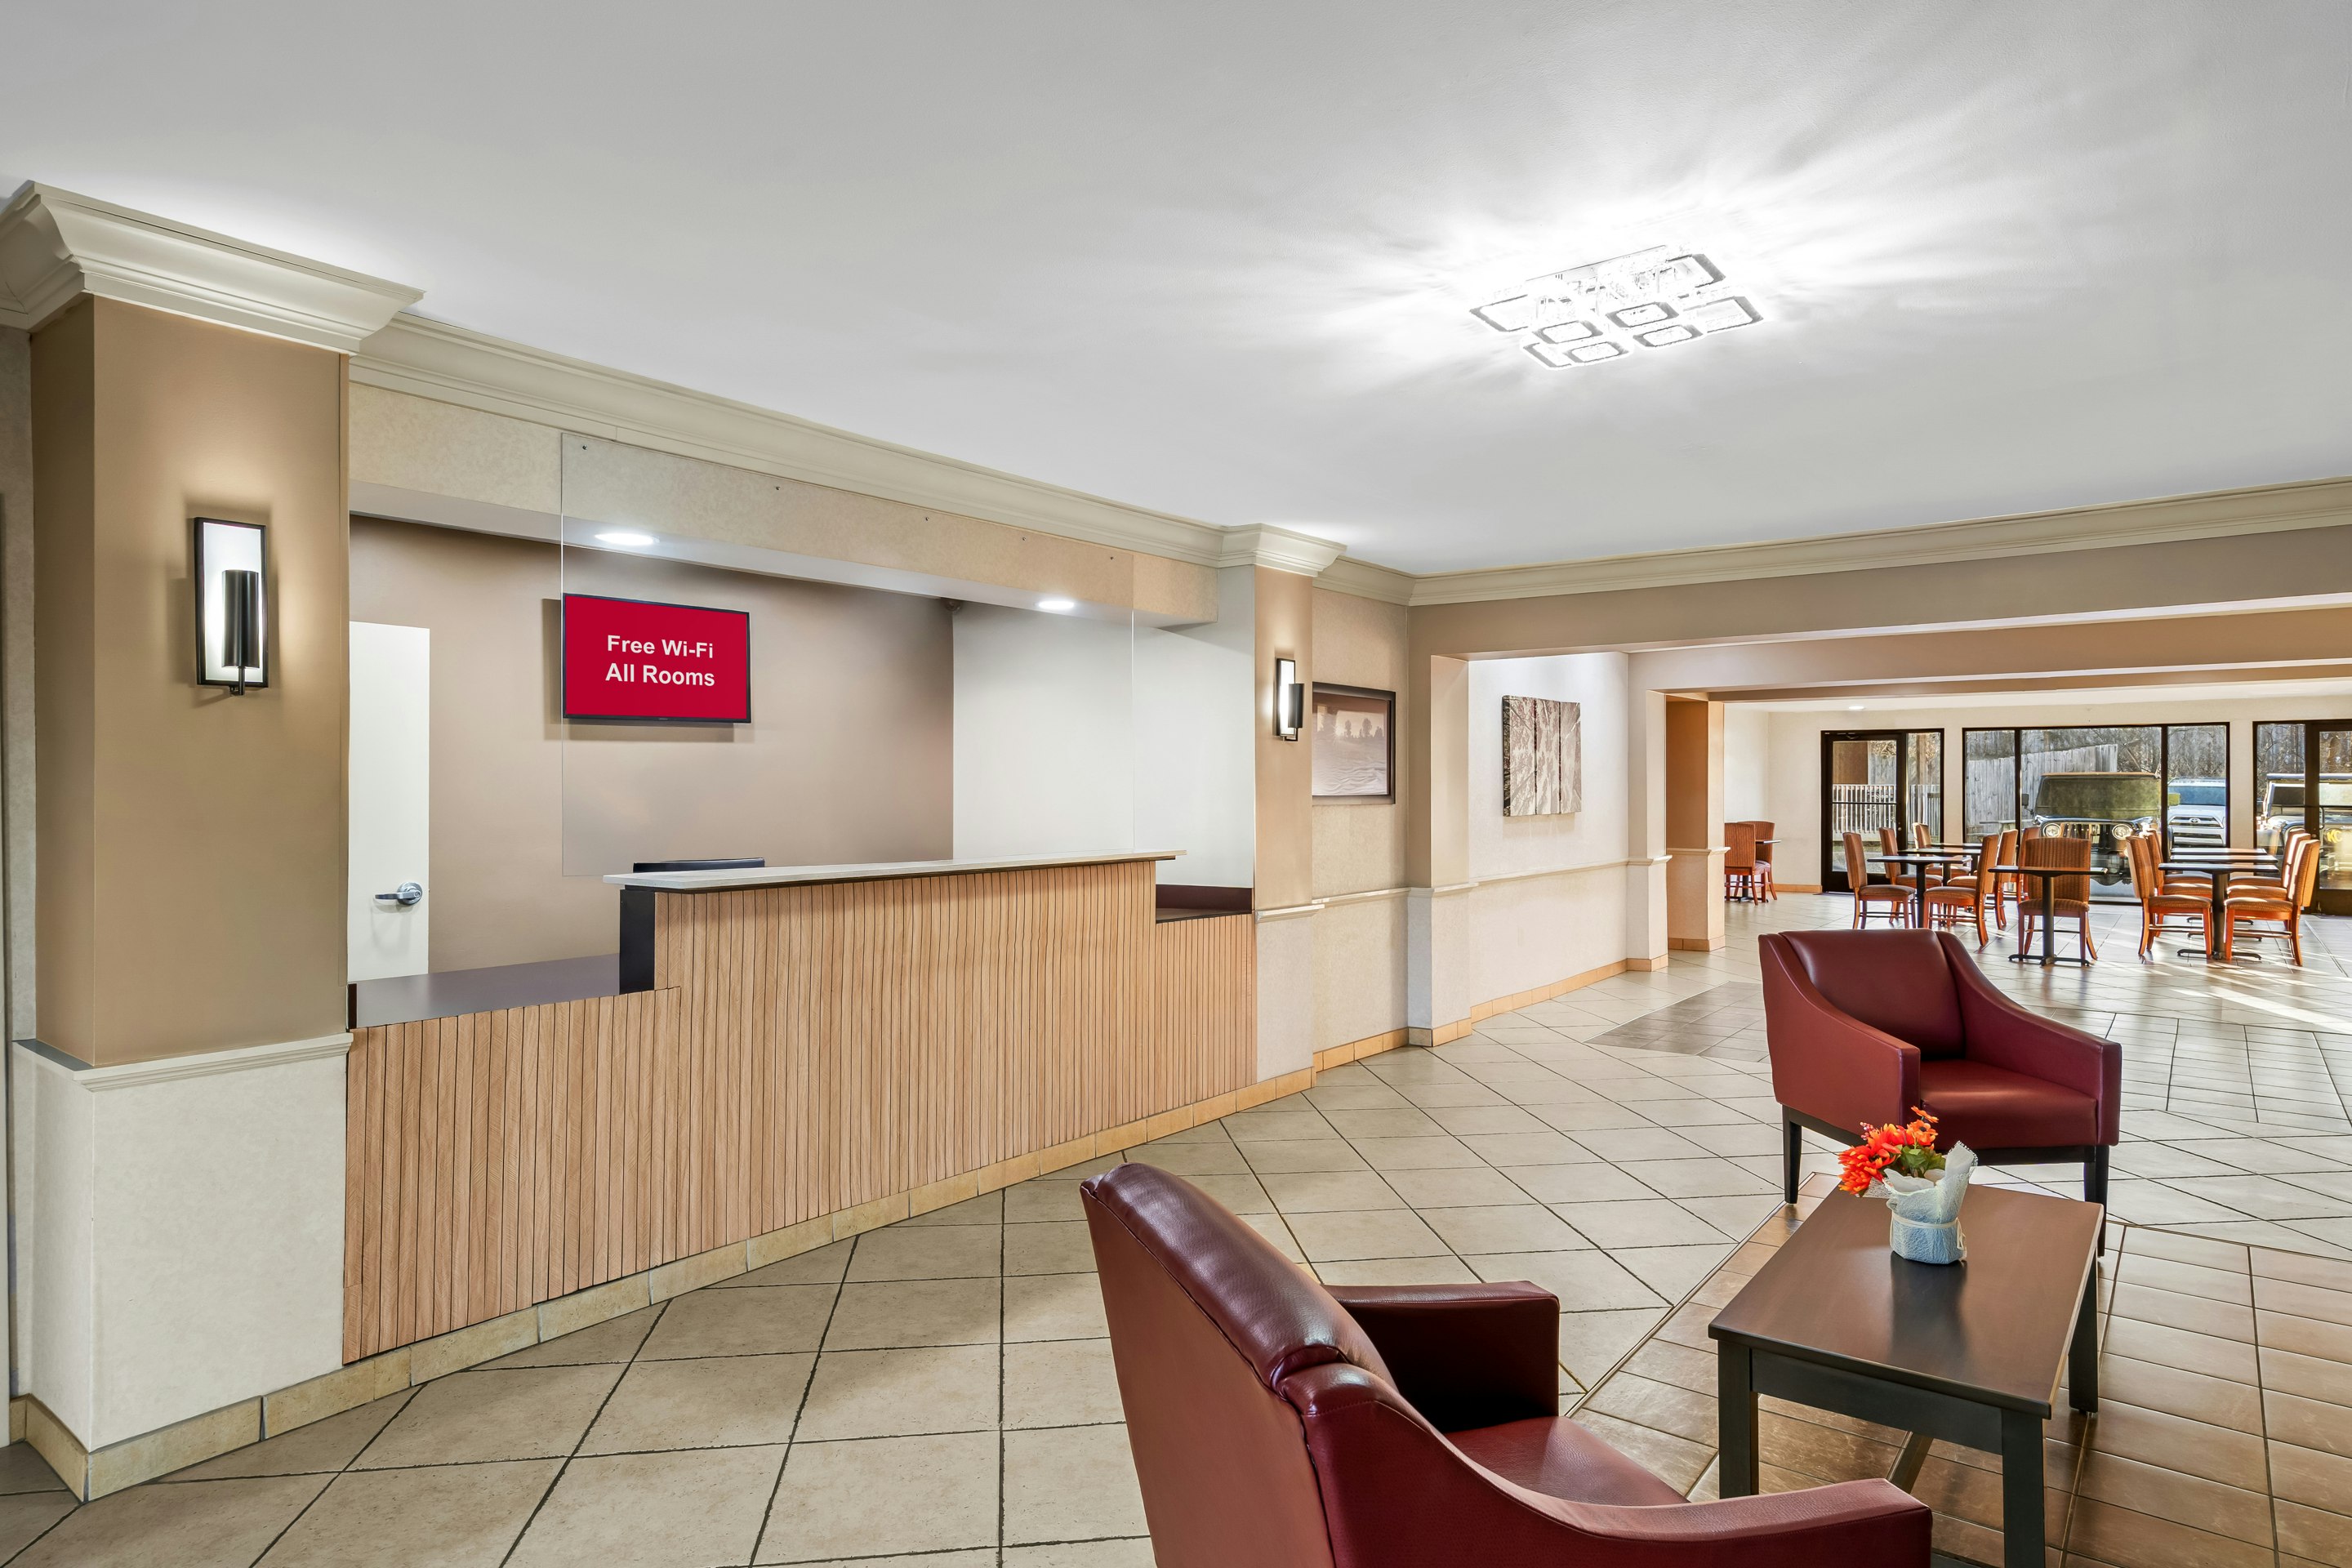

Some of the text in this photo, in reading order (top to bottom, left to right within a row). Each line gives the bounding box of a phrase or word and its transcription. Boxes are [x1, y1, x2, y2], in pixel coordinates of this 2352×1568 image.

[607, 635, 714, 658] Free Wi-Fi
[605, 663, 715, 687] All Rooms
[2326, 829, 2342, 844] KC
